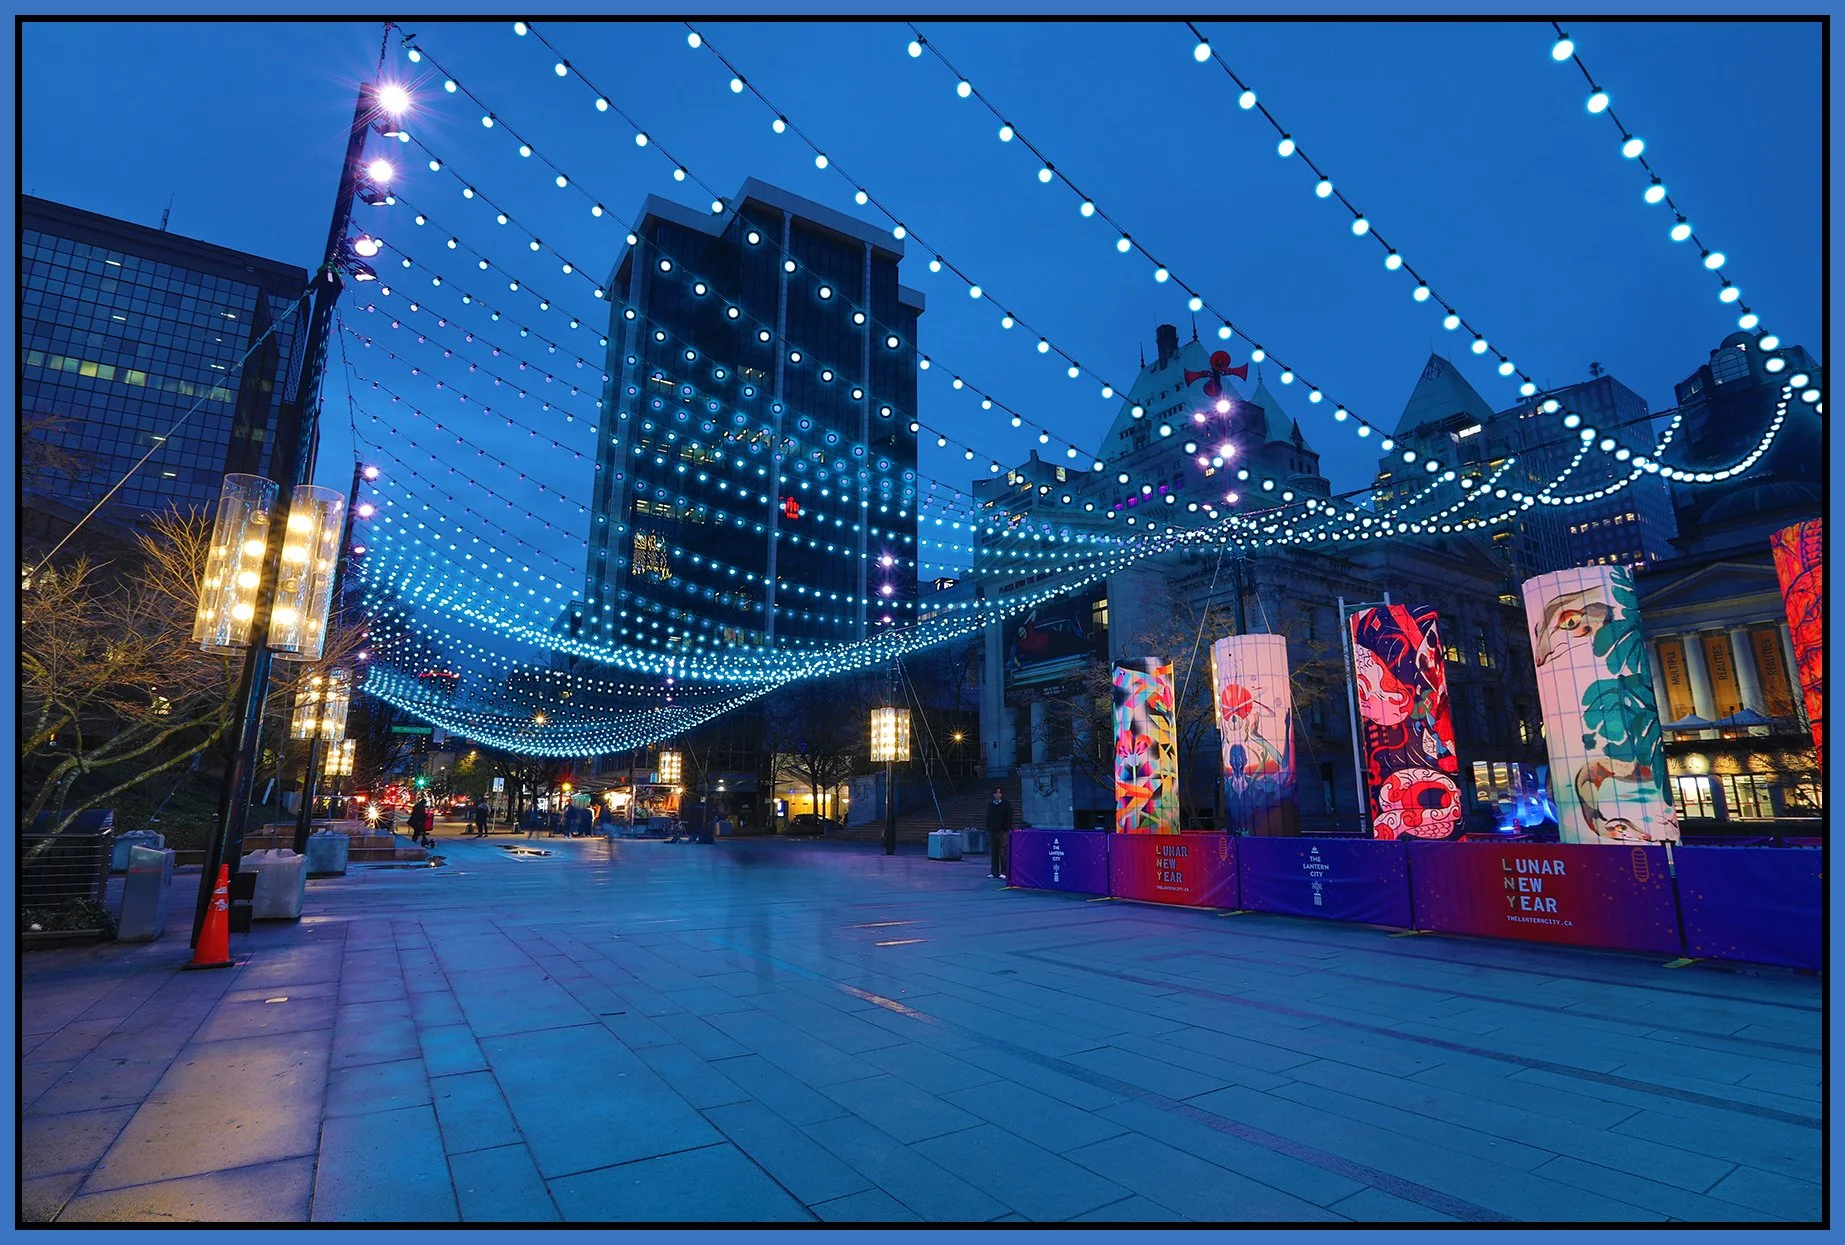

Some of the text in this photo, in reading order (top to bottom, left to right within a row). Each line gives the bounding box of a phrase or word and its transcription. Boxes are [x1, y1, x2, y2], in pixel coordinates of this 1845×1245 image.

[1712, 644, 1728, 681] REALITIES
[1761, 638, 1778, 677] REALITIES
[1666, 650, 1681, 686] MULTIPLE
[1156, 845, 1188, 857] LUNAR
[1156, 858, 1176, 869] NEW
[1502, 858, 1566, 875] LUNAR
[1157, 871, 1183, 883] YEAR
[1503, 877, 1543, 893] NEW
[1506, 895, 1558, 913] YEAR
[1506, 915, 1573, 926] THELANTERNCITY.CA
